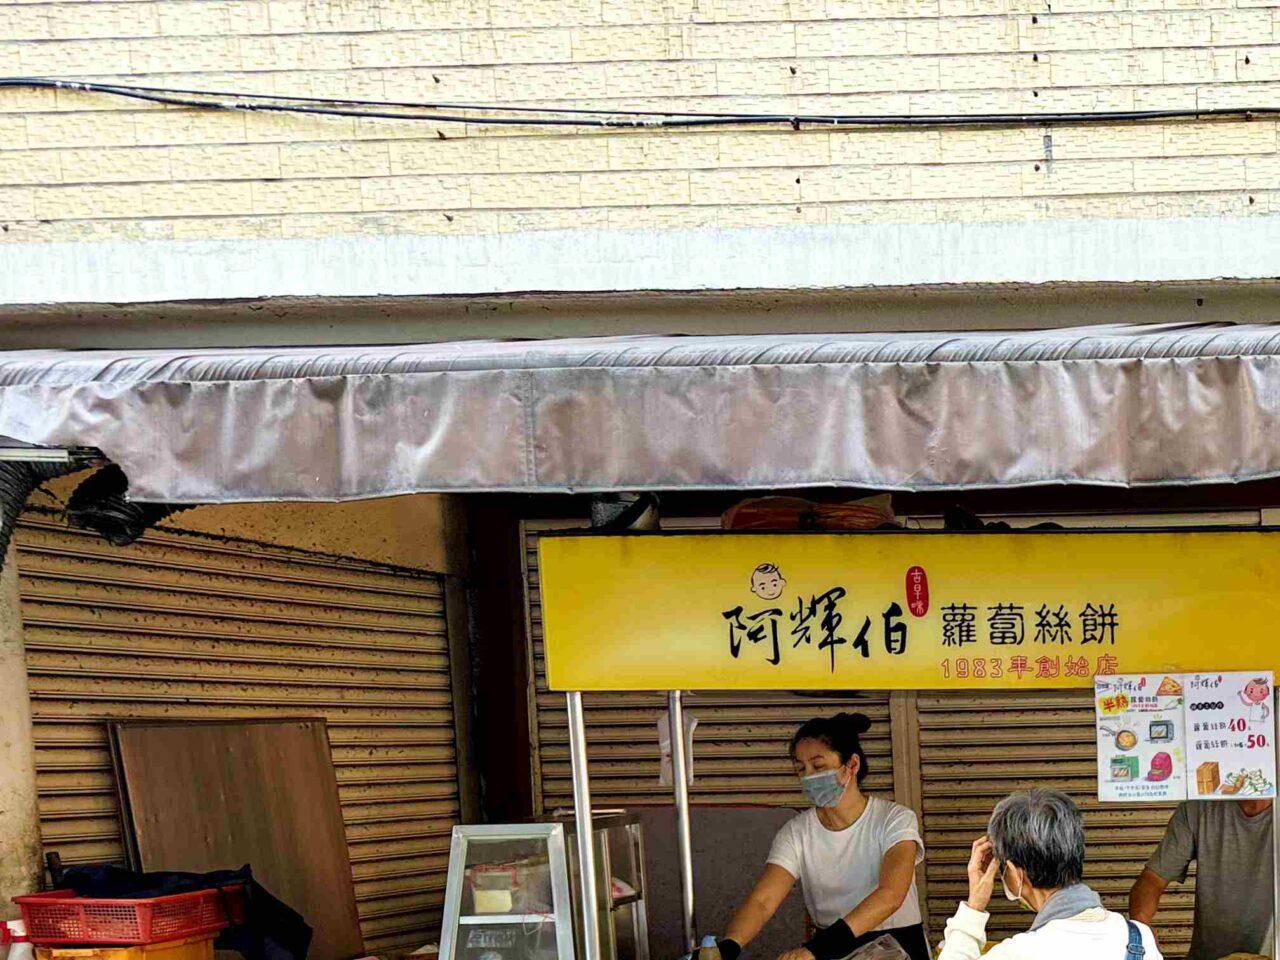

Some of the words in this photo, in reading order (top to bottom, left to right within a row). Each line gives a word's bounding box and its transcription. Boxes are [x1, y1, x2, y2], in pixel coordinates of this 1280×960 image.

[910, 568, 925, 615] 古早味
[722, 587, 908, 674] 阿輝伯
[940, 602, 1119, 647] 蘿蔔絲餅
[940, 654, 1119, 679] 1983年創始店
[1228, 718, 1246, 732] 40
[1246, 734, 1266, 749] 50
